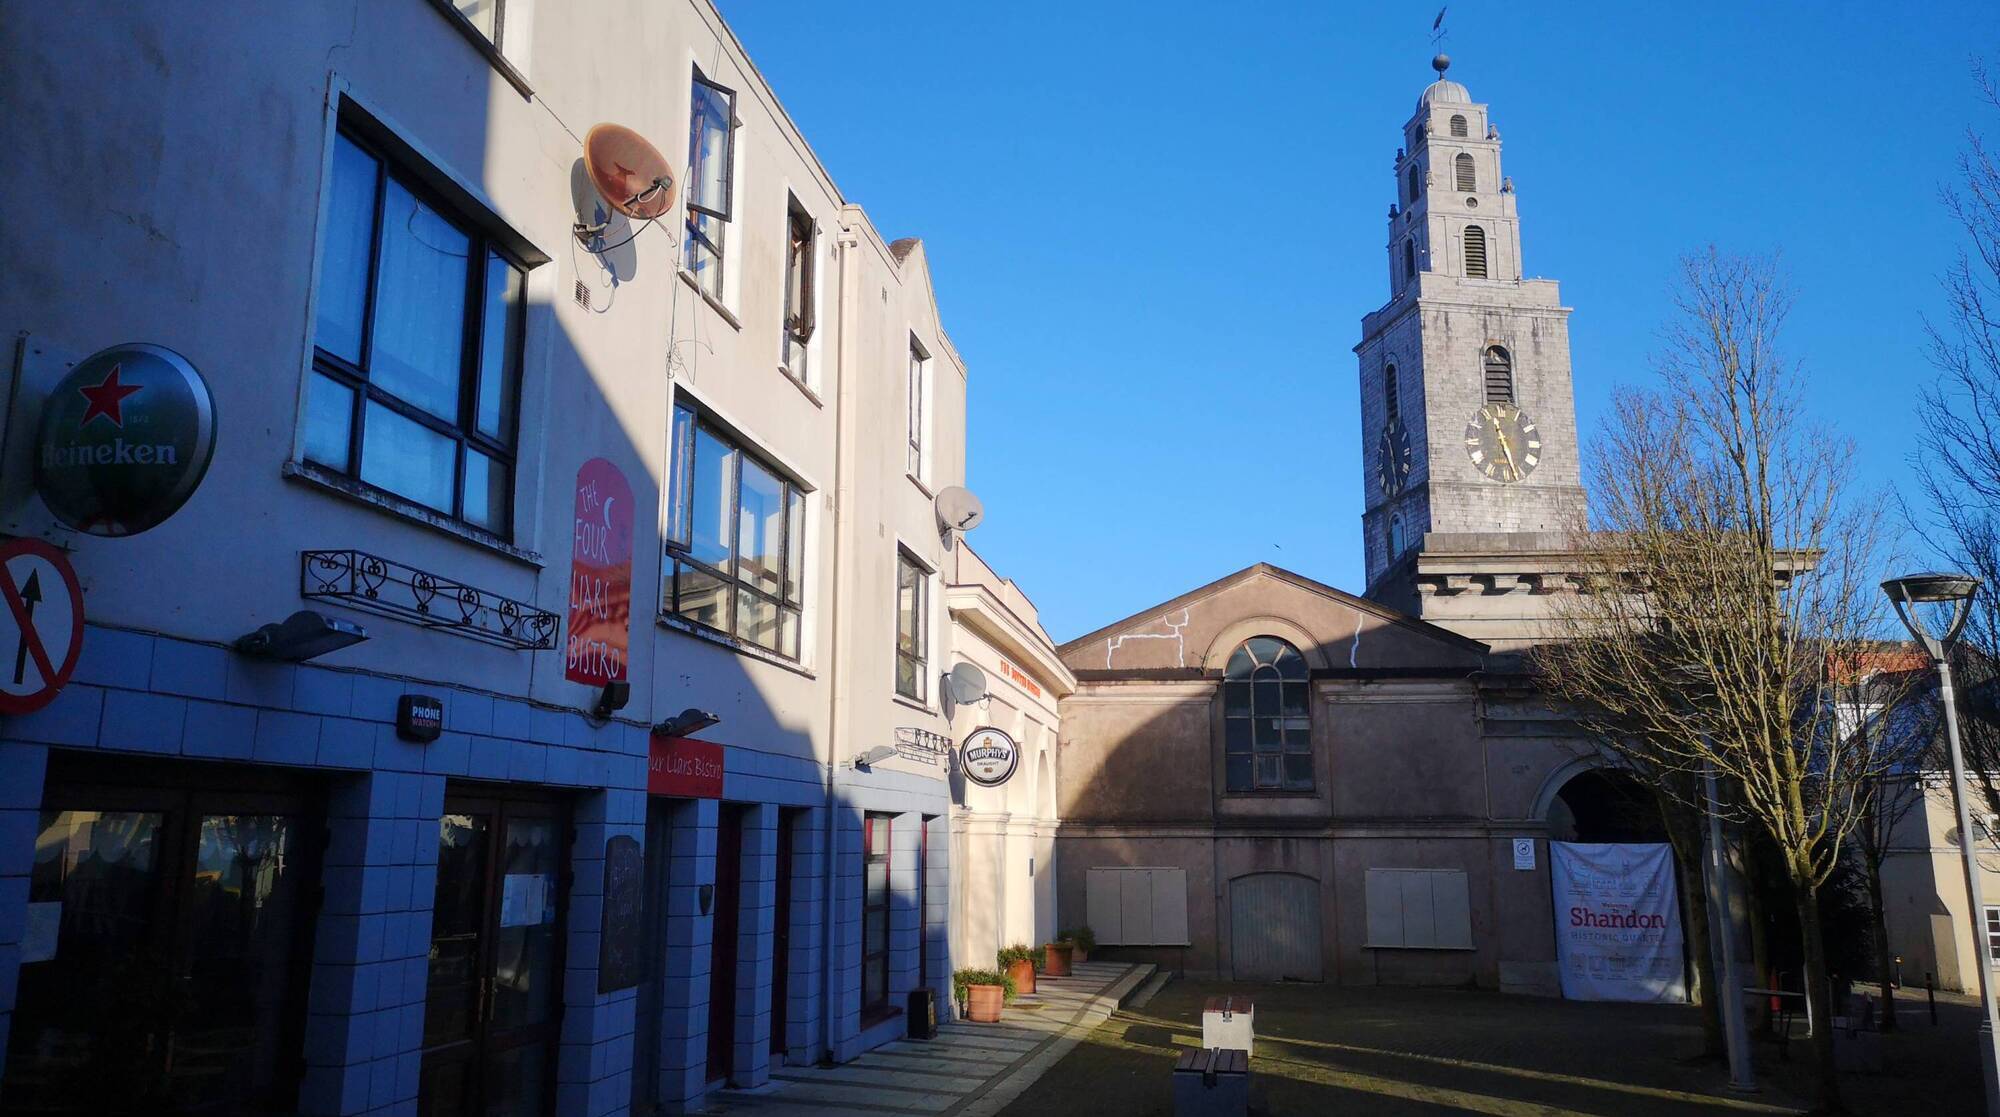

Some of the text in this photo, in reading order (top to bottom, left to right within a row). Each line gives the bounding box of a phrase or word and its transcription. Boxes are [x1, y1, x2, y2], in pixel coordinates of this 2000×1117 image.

[580, 480, 599, 513] THE
[575, 519, 610, 564] FOUR
[570, 570, 610, 619] LIARS
[569, 636, 620, 679] BISTRO
[412, 705, 440, 720] PHONE
[667, 751, 692, 775] Liars
[1570, 907, 1666, 929] Shandon
